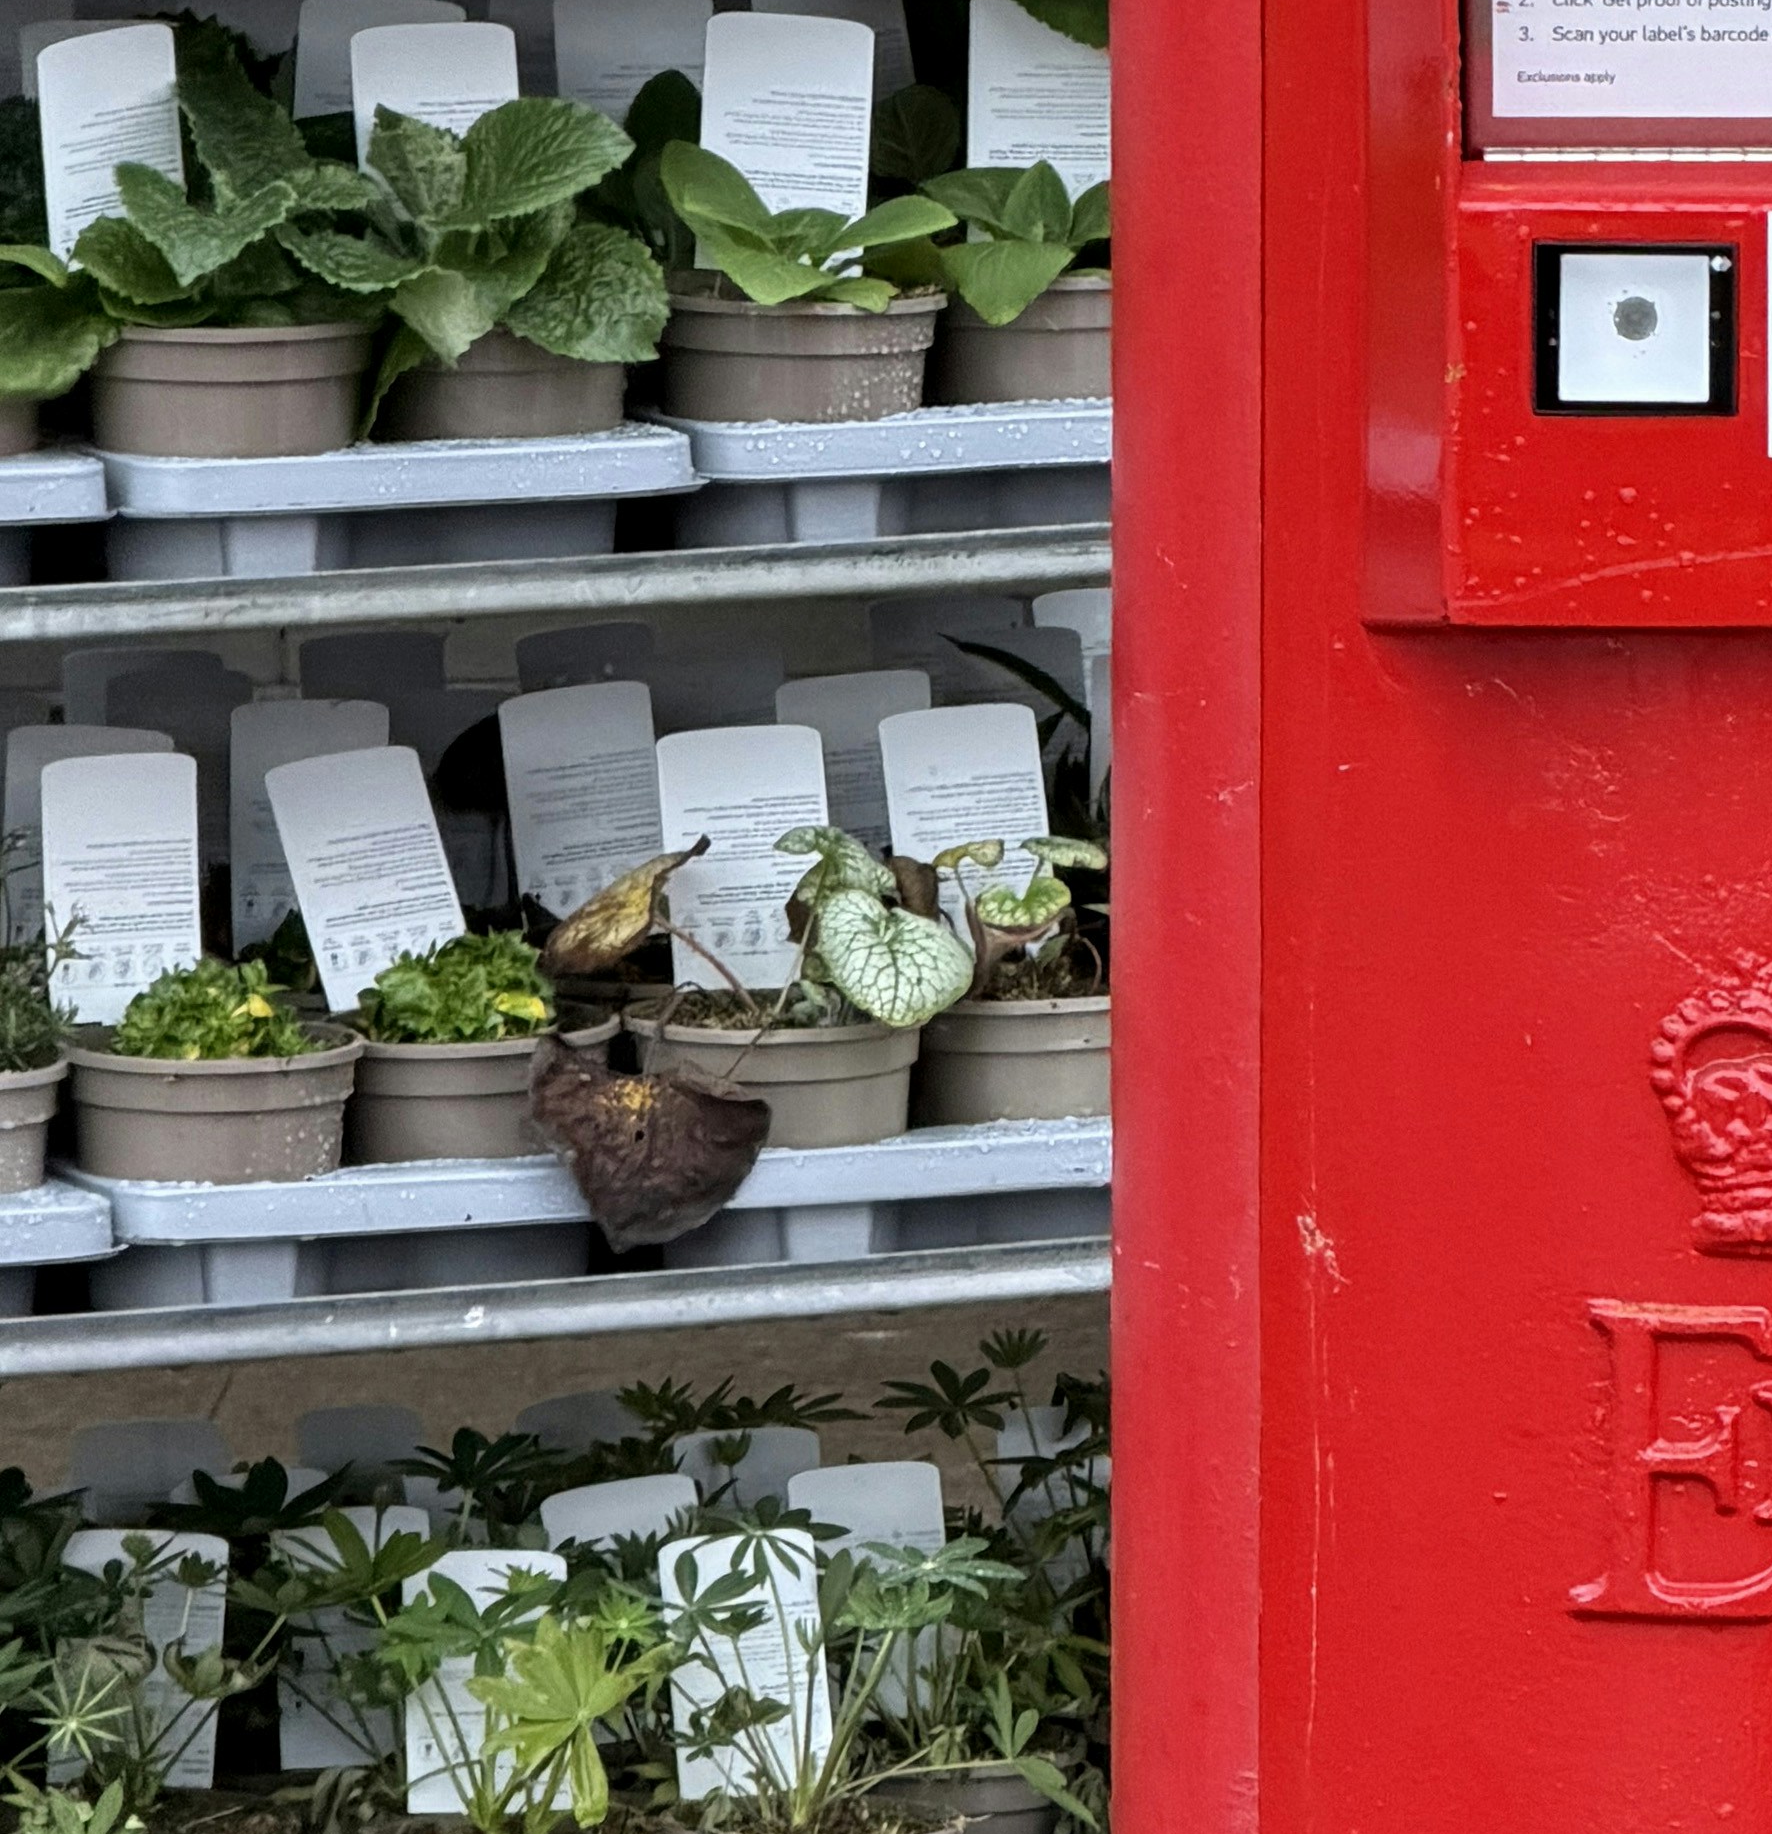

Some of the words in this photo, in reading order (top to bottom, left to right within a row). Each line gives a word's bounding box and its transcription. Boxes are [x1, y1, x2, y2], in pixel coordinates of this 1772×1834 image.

[1518, 27, 1535, 43] 3.
[1552, 25, 1595, 43] Scan
[1598, 28, 1638, 46] your
[1642, 25, 1696, 43] label's
[1701, 25, 1769, 43] barcode
[1517, 70, 1581, 84] Exclusions
[1583, 70, 1616, 86] apply
